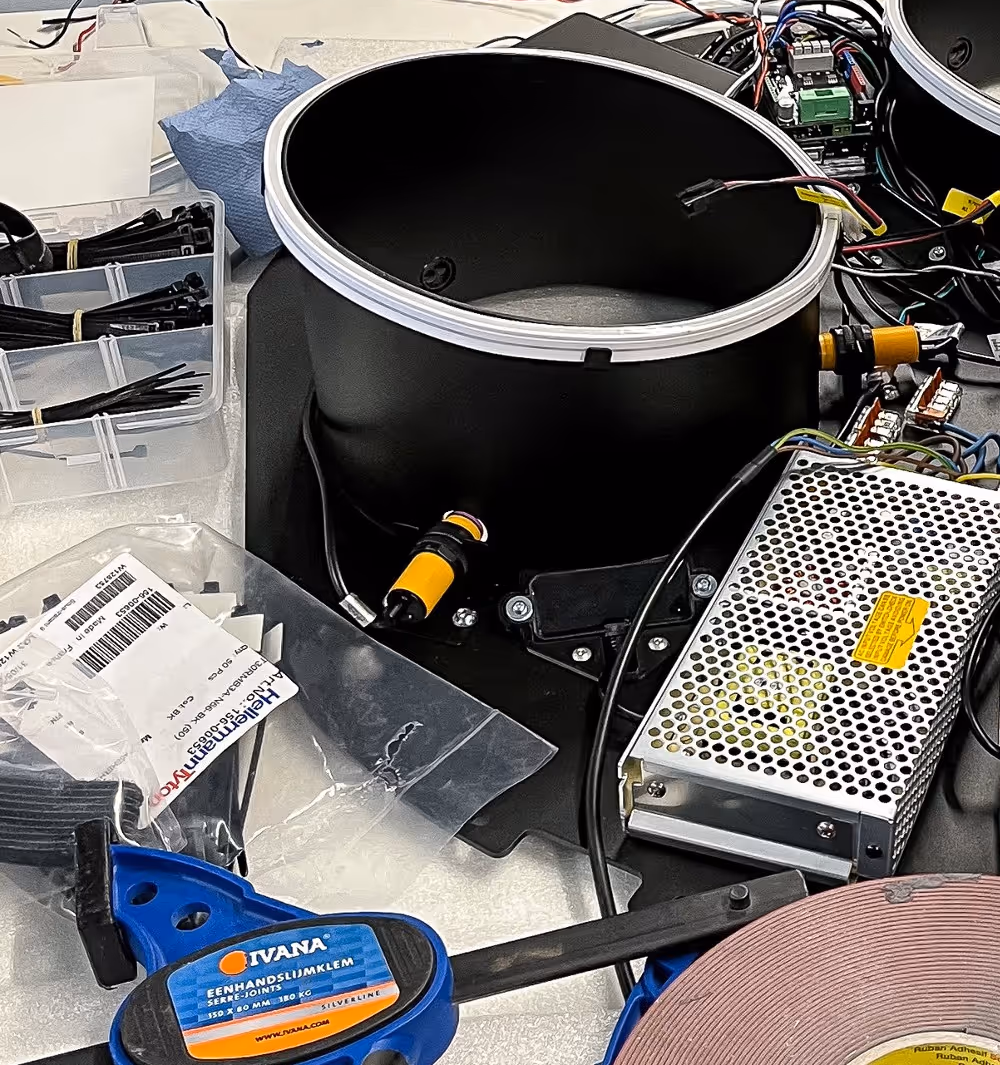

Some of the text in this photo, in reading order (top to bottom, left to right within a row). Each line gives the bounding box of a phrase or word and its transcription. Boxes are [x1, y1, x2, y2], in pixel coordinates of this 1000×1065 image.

[84, 616, 106, 634] Made
[222, 658, 232, 668] 50
[208, 668, 223, 681] Pcs
[167, 709, 180, 720] BK
[174, 724, 192, 740] (50)
[187, 709, 240, 754] 156-00653
[149, 688, 280, 808] HellermannTyton
[250, 938, 327, 967] IVANA
[207, 957, 354, 998] EENHANDSLIJMKLEM
[207, 984, 282, 1007] SERRE-JOINTS
[207, 1010, 224, 1019] 150
[252, 999, 271, 1010] MM
[298, 990, 312, 998] KG
[321, 990, 381, 1010] SILVERLINE
[255, 1019, 330, 1042] WWW.IVANA.COM
[914, 1045, 946, 1053] Ruban
[936, 1053, 968, 1061] Ruban
